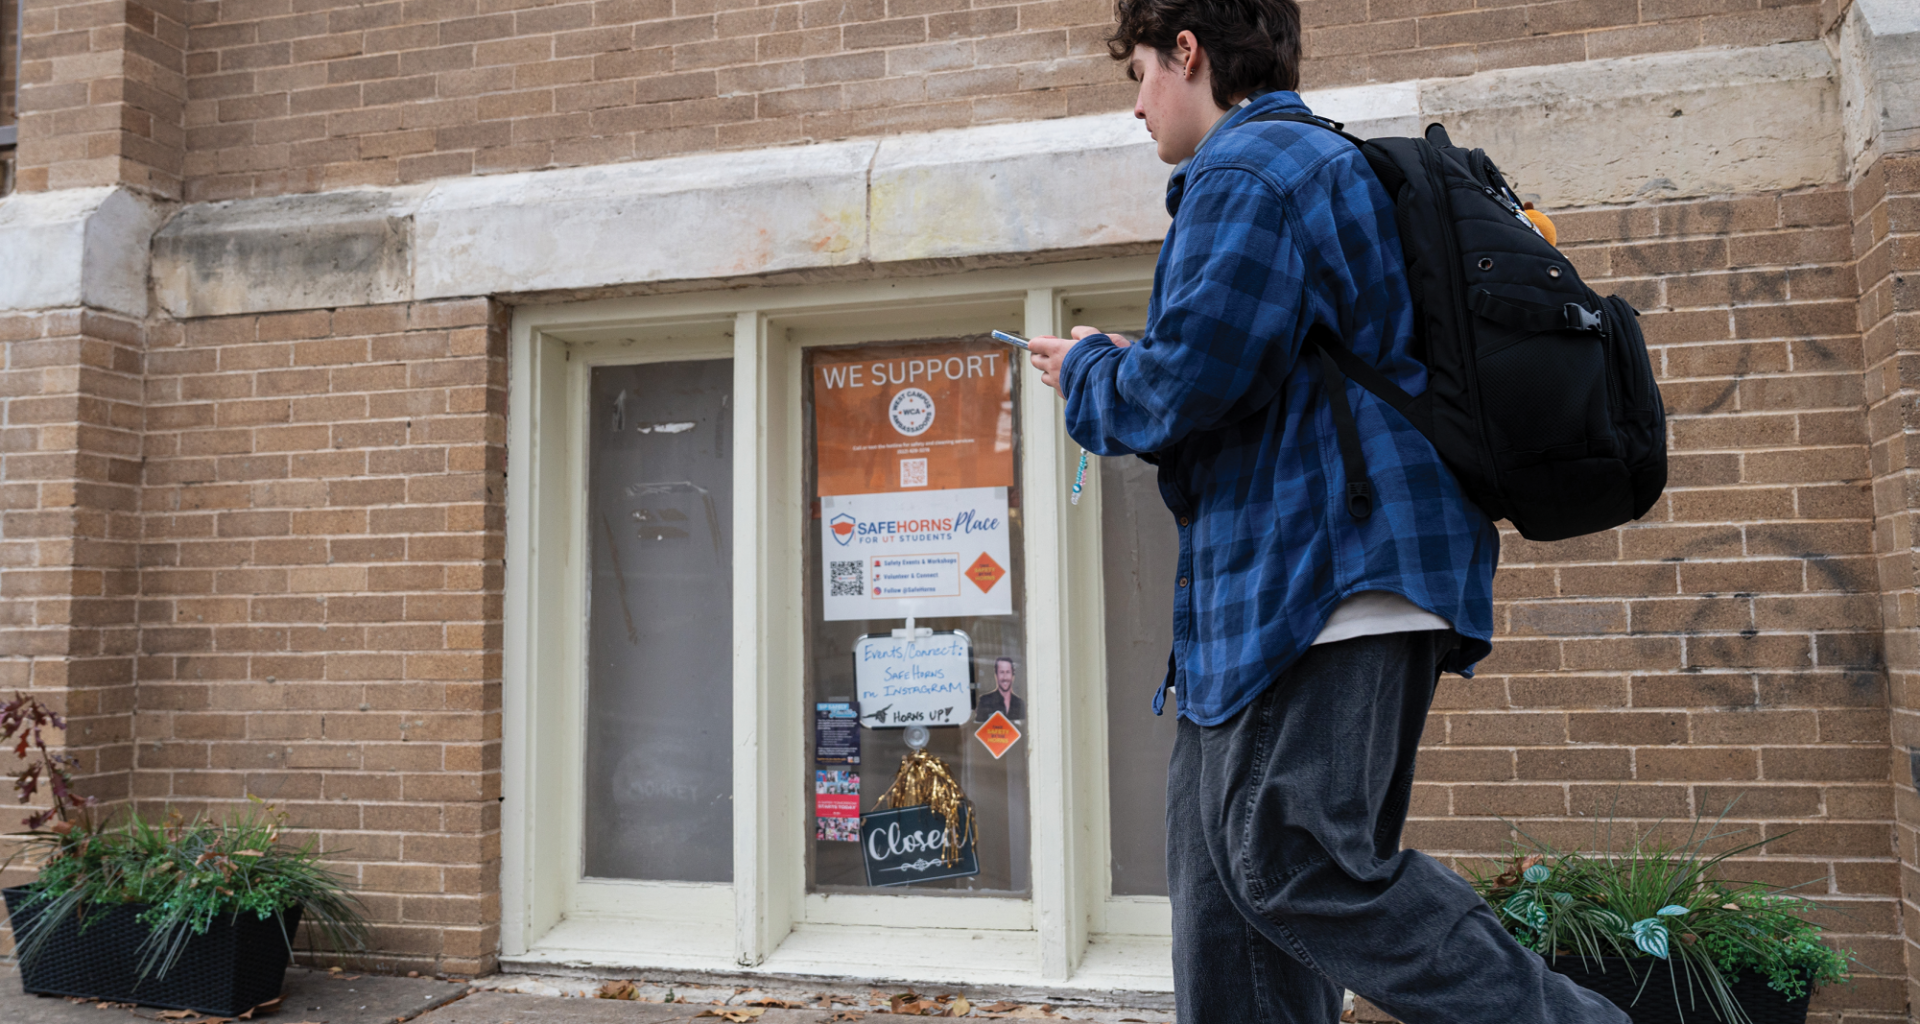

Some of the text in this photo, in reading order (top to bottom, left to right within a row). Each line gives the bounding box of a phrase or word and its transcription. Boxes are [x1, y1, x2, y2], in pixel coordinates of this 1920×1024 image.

[823, 354, 999, 389] WE SUPPORT
[893, 391, 932, 411] WEST CAMPUS
[903, 408, 921, 416] WCA
[893, 412, 932, 433] AMBASSADORS
[857, 509, 1000, 535] SAFEHORNS Place
[900, 533, 952, 542] STUDENTS
[893, 707, 954, 723] HORNS UP!
